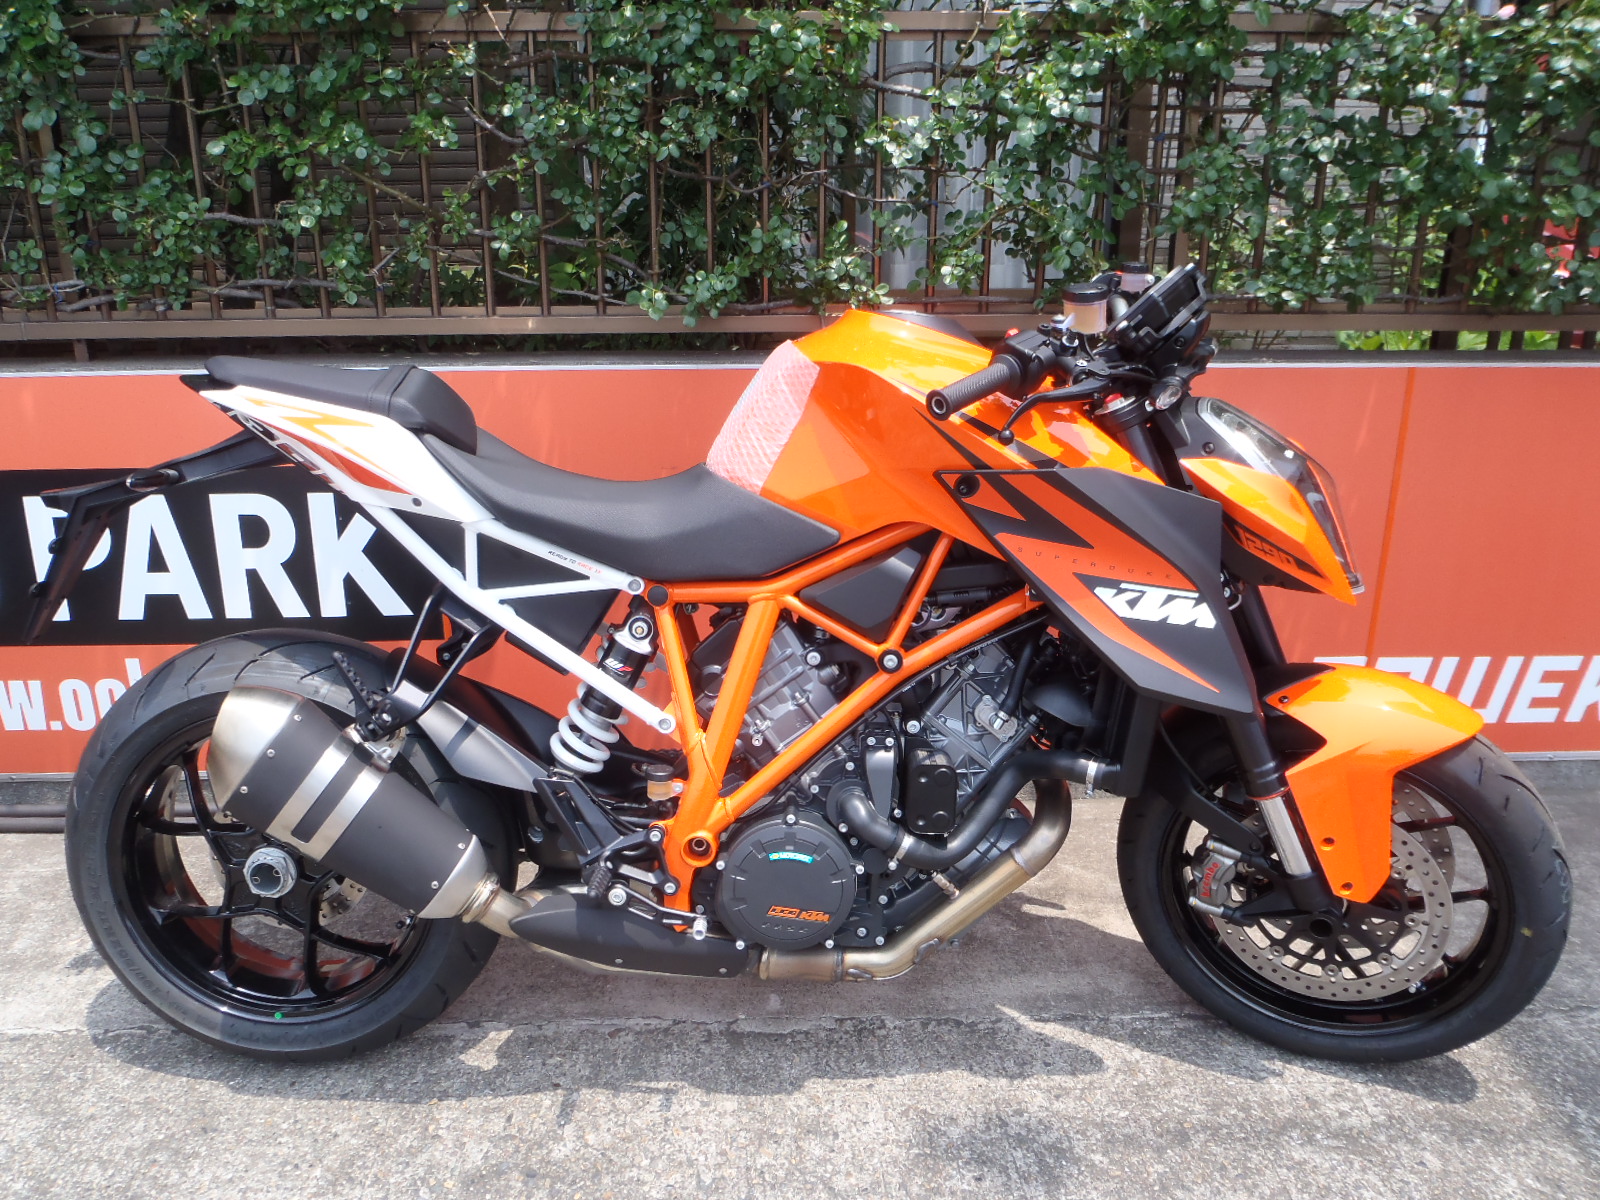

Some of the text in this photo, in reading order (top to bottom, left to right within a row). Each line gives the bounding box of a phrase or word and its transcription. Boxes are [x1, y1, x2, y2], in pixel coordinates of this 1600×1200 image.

[1094, 582, 1217, 629] KTM
[1200, 861, 1220, 897] brembo
[799, 910, 830, 922] KTM
